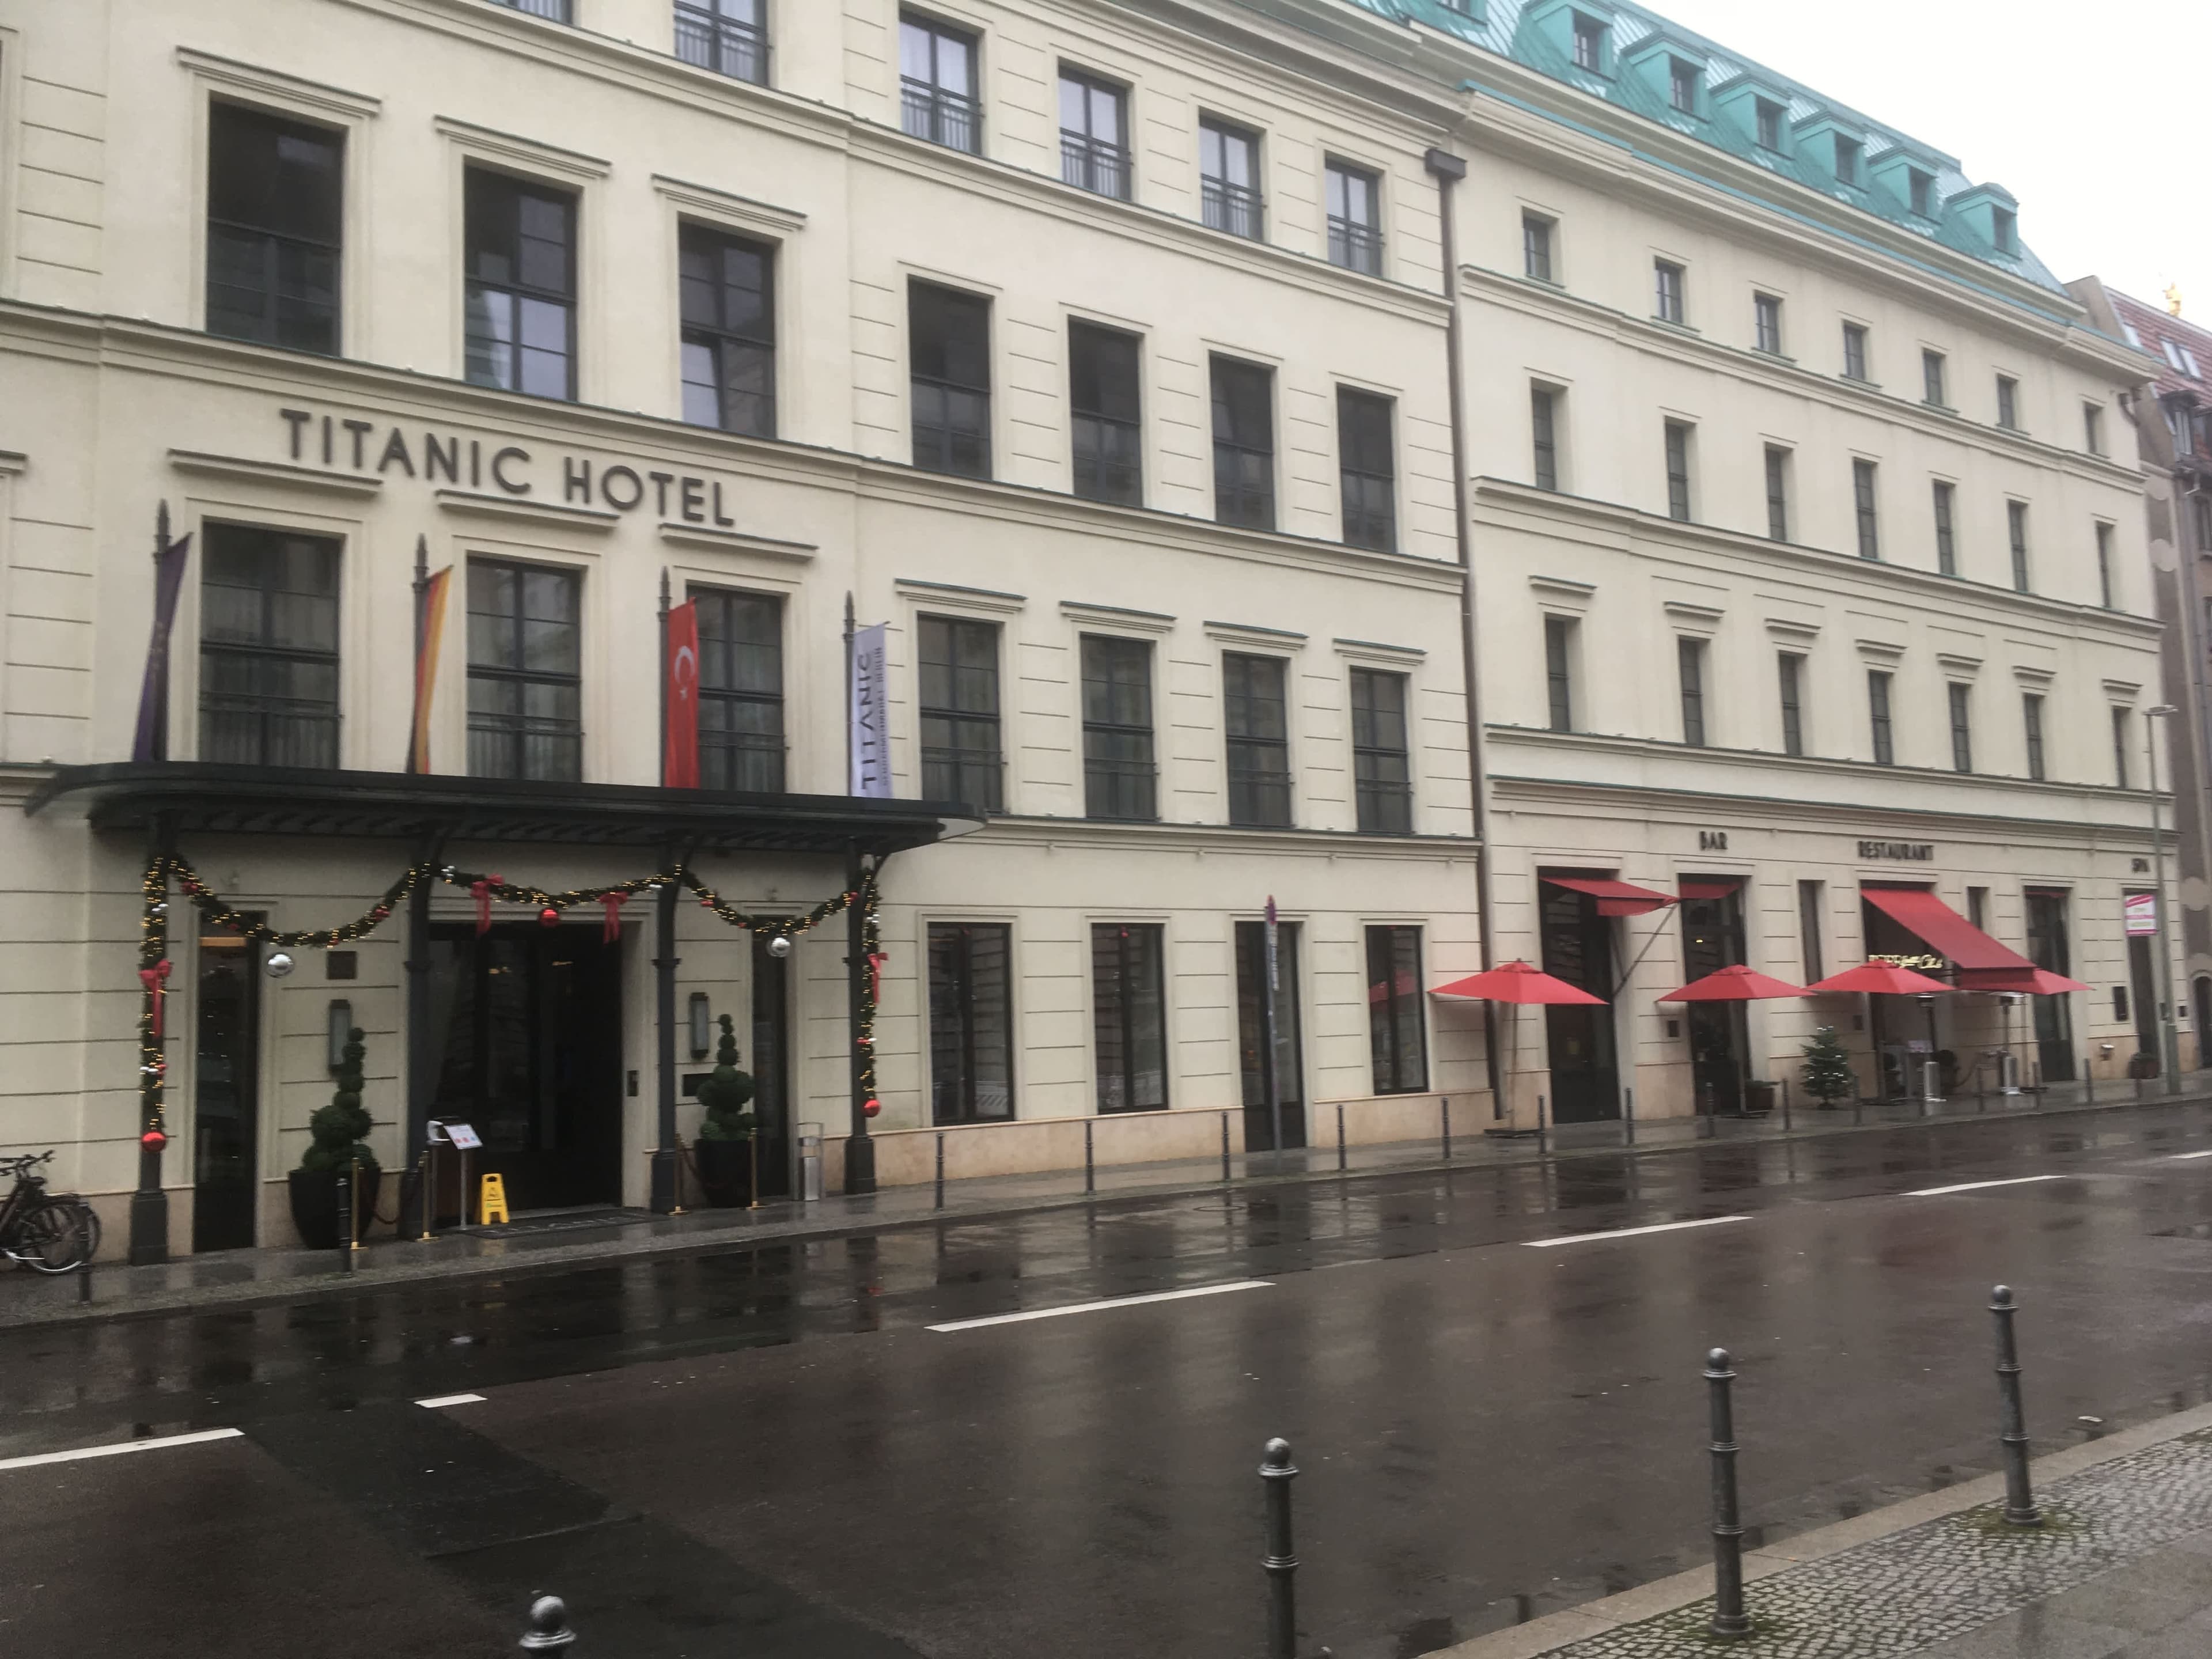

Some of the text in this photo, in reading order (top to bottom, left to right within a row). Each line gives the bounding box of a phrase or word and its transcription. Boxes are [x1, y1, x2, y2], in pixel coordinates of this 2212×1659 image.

[280, 408, 735, 527] TITANIC HOTEL
[857, 654, 876, 789] TITANIC
[1699, 831, 1728, 851] BAR
[1857, 840, 1934, 861] RESTAURANT
